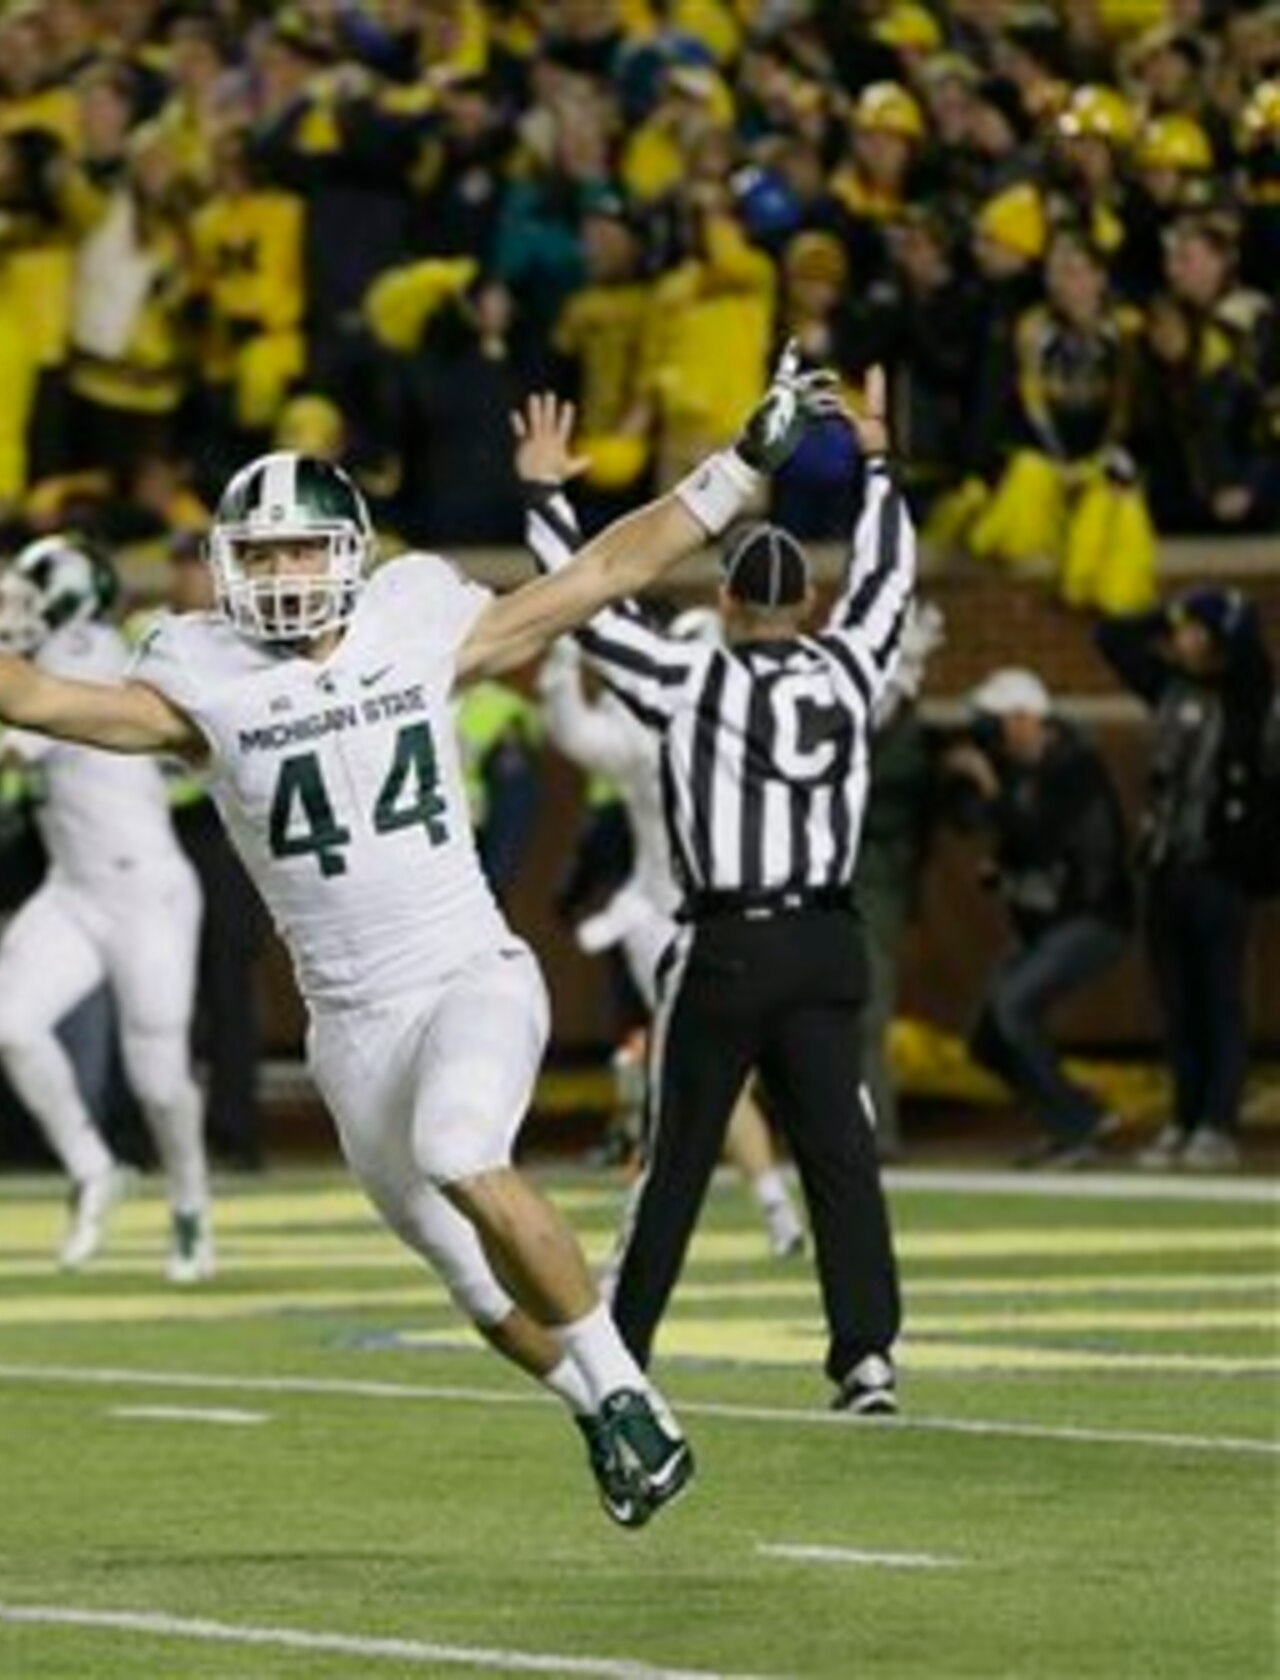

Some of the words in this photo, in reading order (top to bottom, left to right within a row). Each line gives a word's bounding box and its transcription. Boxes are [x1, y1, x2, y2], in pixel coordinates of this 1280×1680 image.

[238, 705, 357, 754] MICHIGAN
[361, 684, 427, 725] STATE
[769, 673, 836, 779] C
[269, 720, 450, 876] 44
